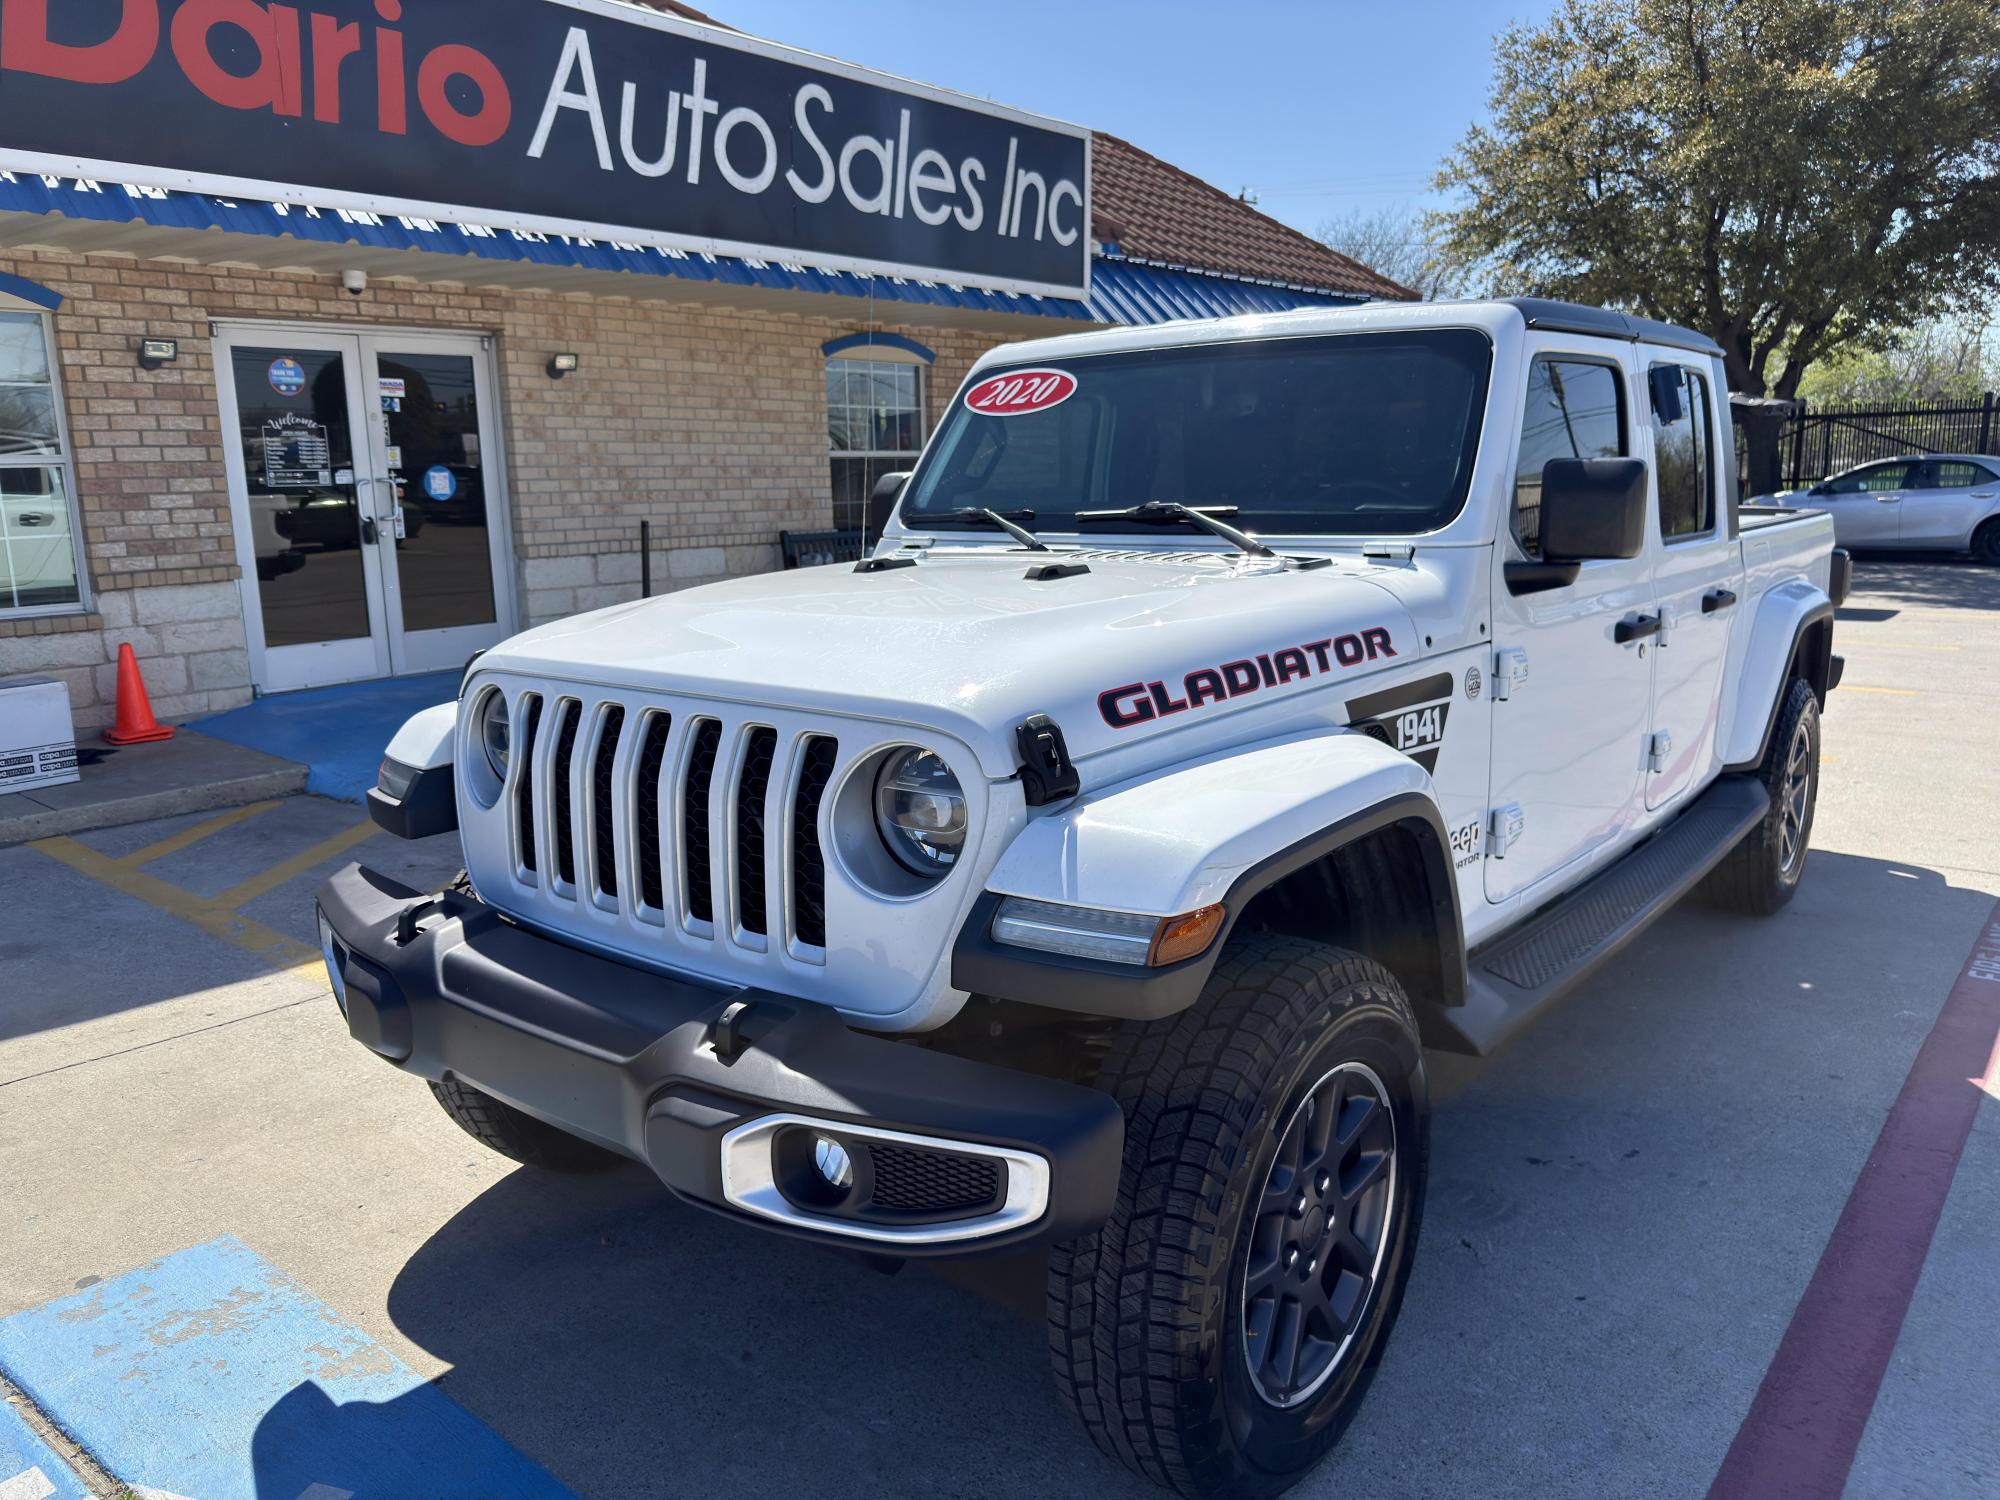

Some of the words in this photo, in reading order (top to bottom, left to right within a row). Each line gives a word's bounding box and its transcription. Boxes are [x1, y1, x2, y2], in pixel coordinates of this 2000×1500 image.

[527, 27, 777, 194] Auto
[785, 83, 986, 232] Sales
[998, 137, 1083, 247] Inc
[976, 375, 1062, 407] 2020
[267, 412, 319, 430] Welcome
[1097, 626, 1398, 729] GLADIATOR
[1396, 706, 1442, 750] 1941
[1450, 821, 1480, 853] eep
